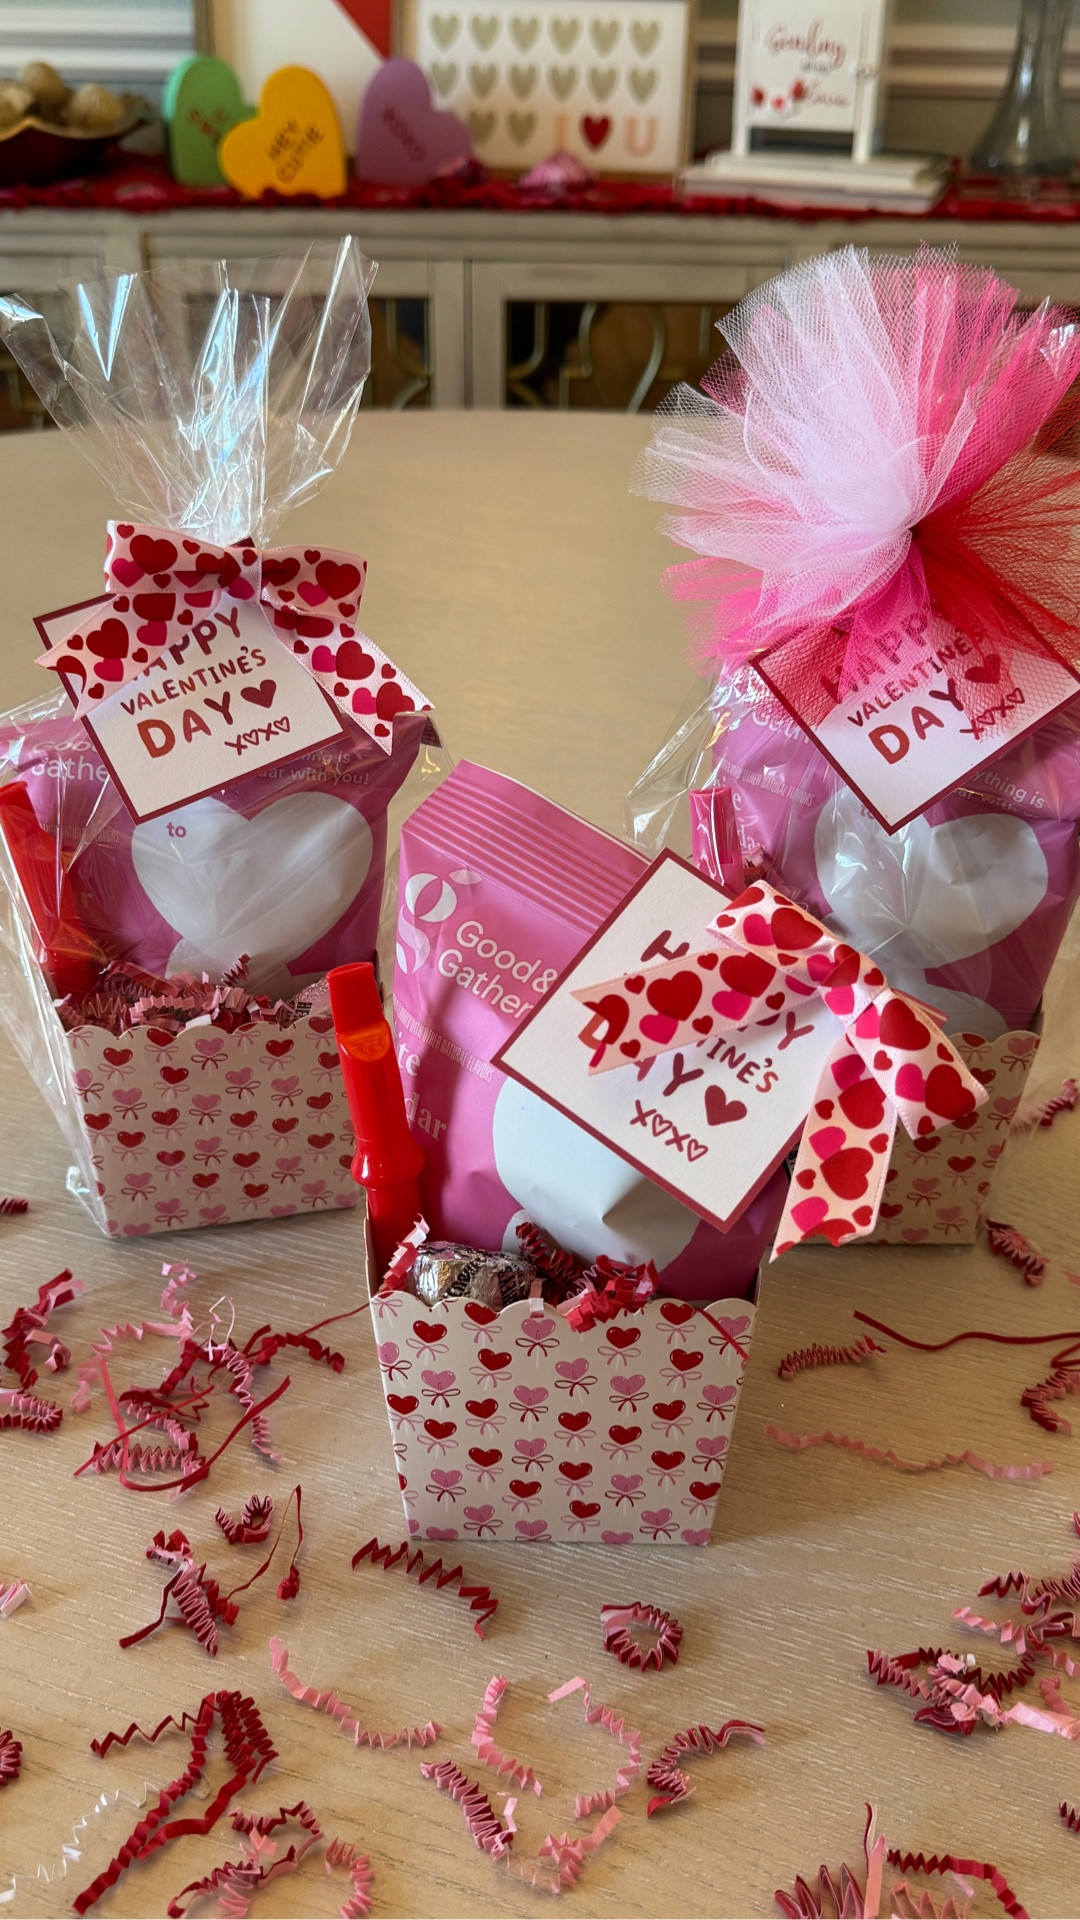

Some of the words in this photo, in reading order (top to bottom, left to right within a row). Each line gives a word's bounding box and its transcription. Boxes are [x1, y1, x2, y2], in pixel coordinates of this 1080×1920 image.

[267, 117, 298, 162] HEY
[276, 126, 325, 184] CUTIE
[120, 645, 267, 715] VALENTINE'S
[137, 691, 233, 758] DAY
[868, 678, 964, 765] DAY
[291, 767, 327, 783] with
[334, 772, 369, 786] you!
[1030, 791, 1045, 809] is
[166, 822, 187, 838] to
[438, 948, 535, 1019] Gather
[439, 1037, 470, 1066] NATURAL
[465, 1054, 496, 1084] FLAVORS
